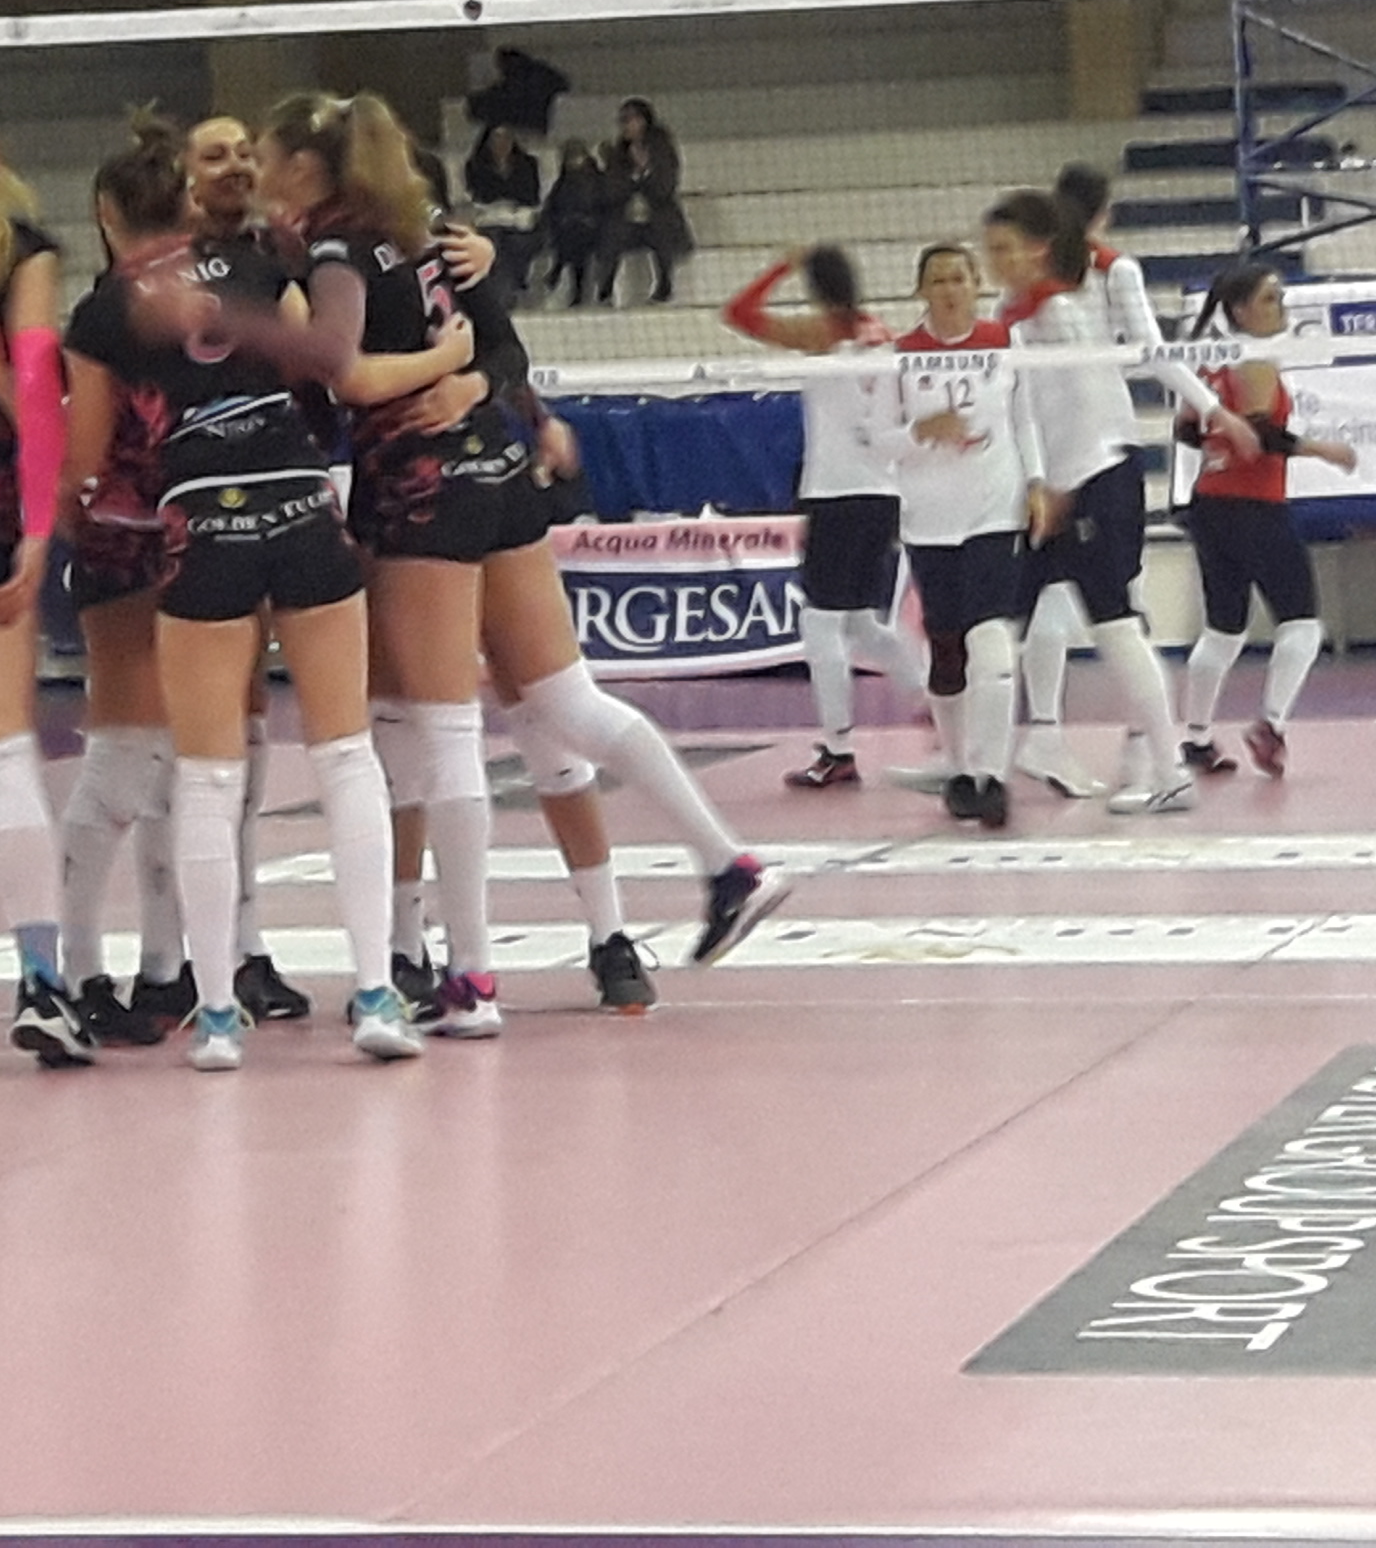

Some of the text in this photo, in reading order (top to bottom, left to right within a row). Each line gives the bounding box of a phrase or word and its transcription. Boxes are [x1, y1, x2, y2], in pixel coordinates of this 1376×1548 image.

[899, 353, 999, 373] SAMSUNG
[572, 526, 785, 555] Acqua Minerale
